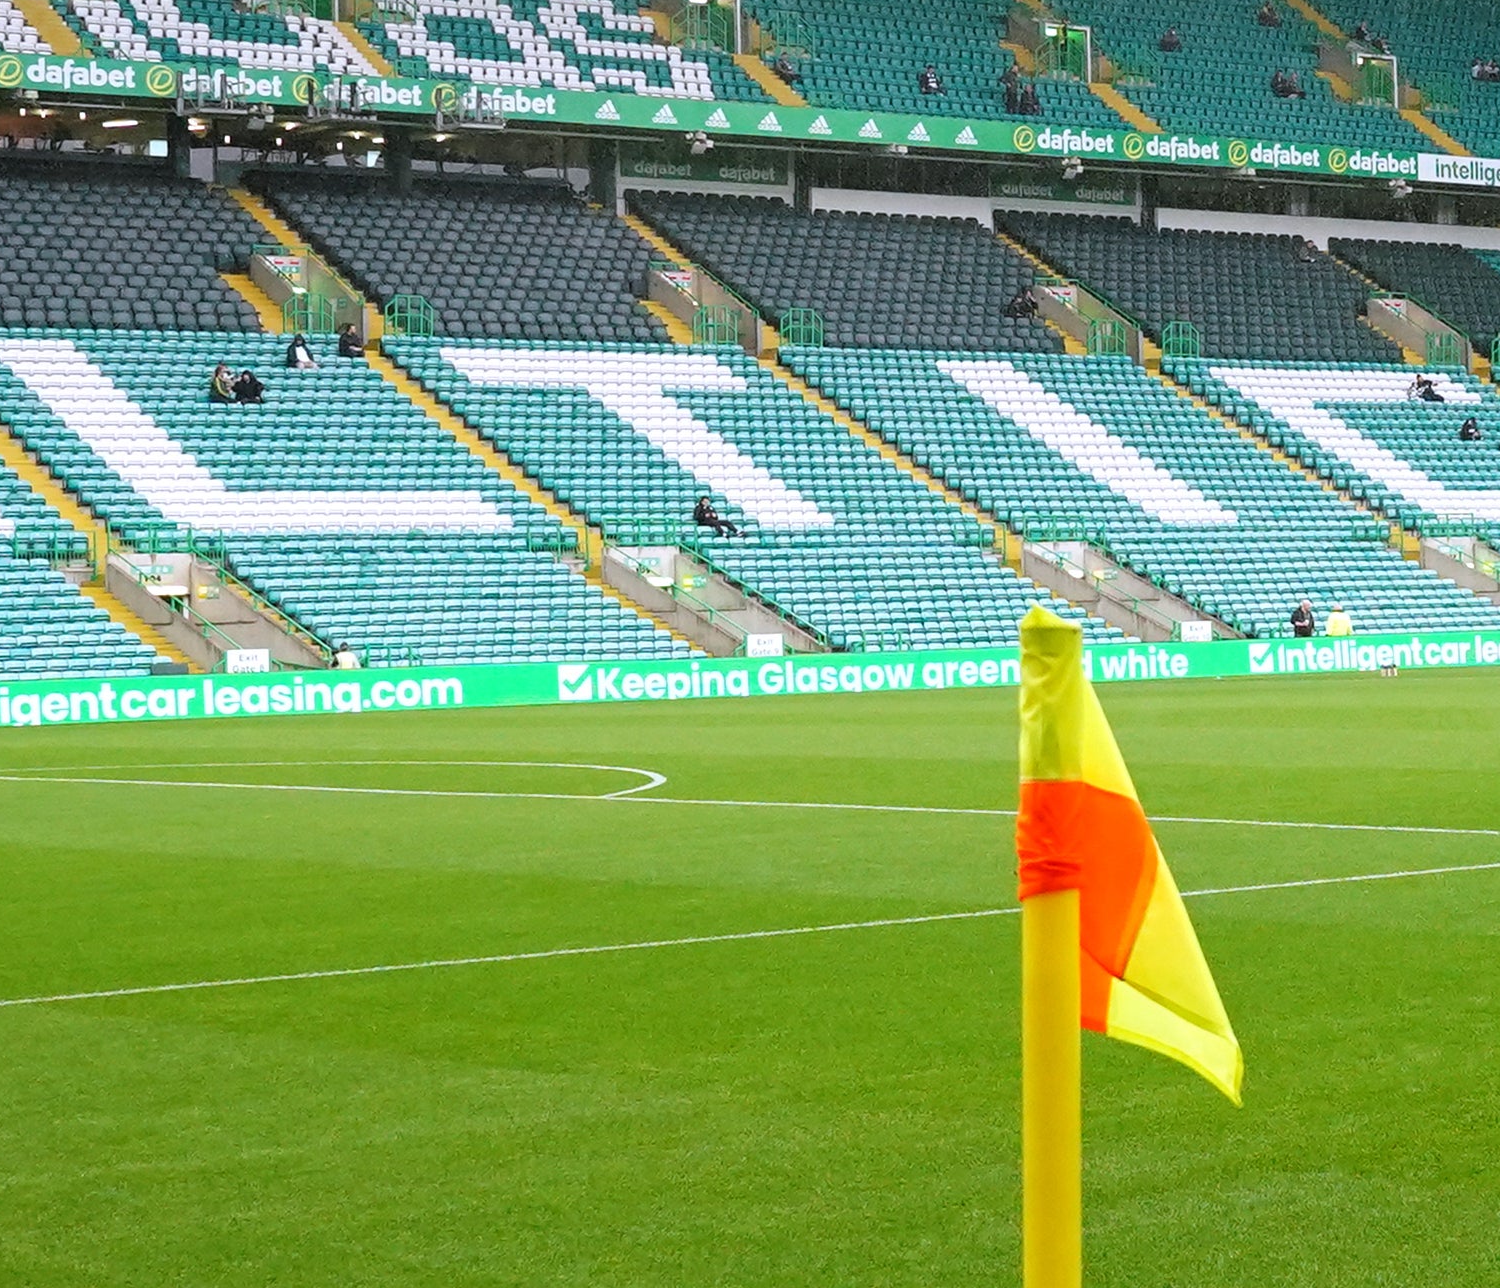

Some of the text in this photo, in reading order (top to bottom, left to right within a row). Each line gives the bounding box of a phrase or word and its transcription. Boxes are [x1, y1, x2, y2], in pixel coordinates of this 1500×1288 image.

[26, 58, 136, 89] dafabet
[183, 68, 283, 100] dafabet
[462, 85, 556, 115] dafabet
[1036, 128, 1114, 154] dafabet
[1146, 136, 1220, 162] dafabet
[1250, 143, 1320, 168] dafabet
[1349, 151, 1417, 175] dafabet
[238, 653, 258, 662] Exit
[598, 662, 750, 700] Keeping
[757, 660, 915, 695] Glasgow
[922, 660, 1022, 690] green
[1102, 642, 1190, 679] white
[203, 671, 464, 715] leasing.com
